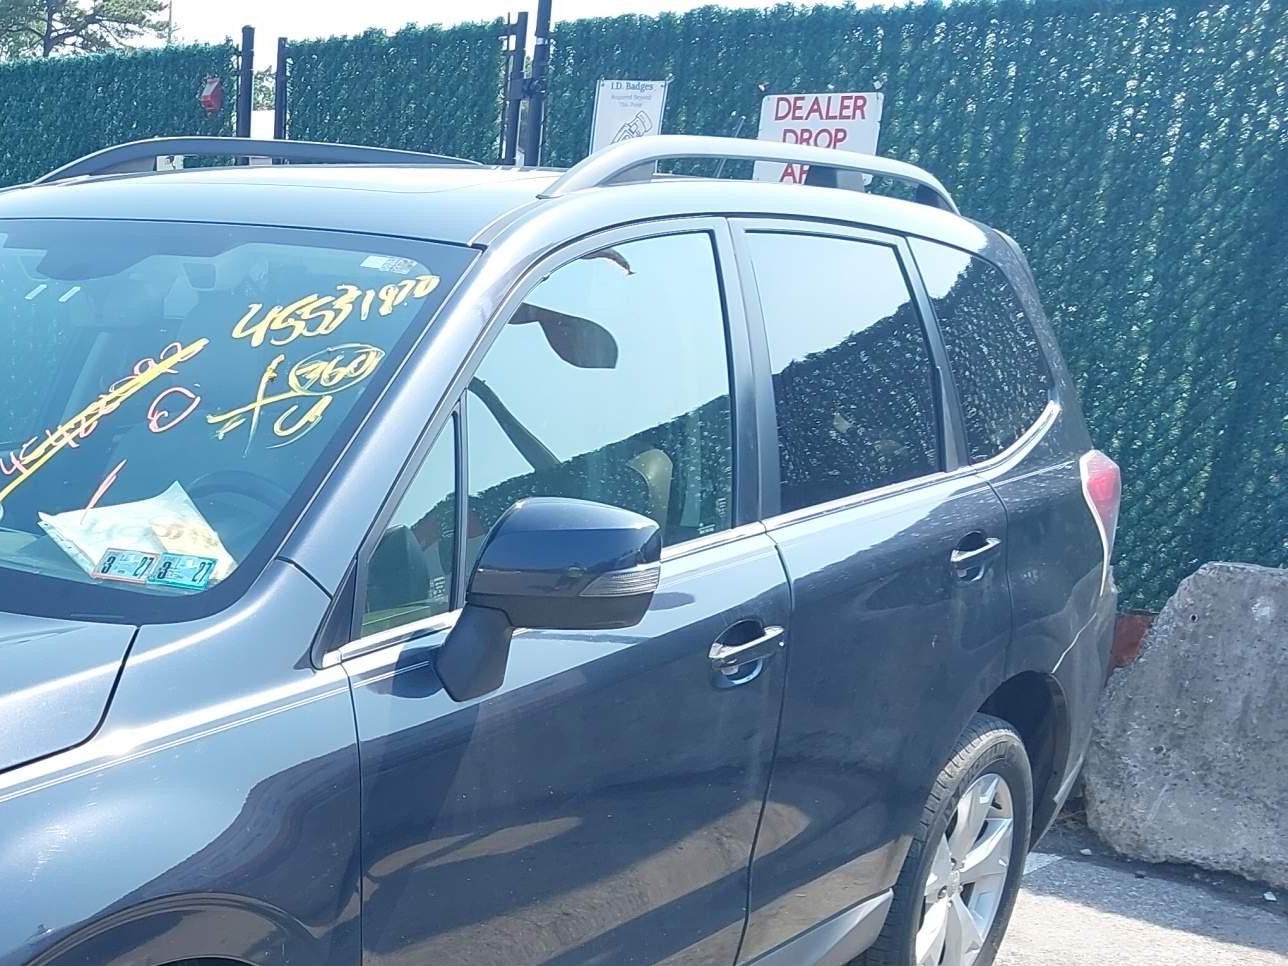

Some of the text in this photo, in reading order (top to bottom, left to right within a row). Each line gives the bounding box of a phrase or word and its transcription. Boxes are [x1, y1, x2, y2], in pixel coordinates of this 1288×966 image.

[626, 82, 654, 92] Badges
[775, 96, 867, 120] DEALER
[783, 128, 847, 149] DROP
[133, 556, 155, 578] 27
[192, 561, 214, 583] 27
